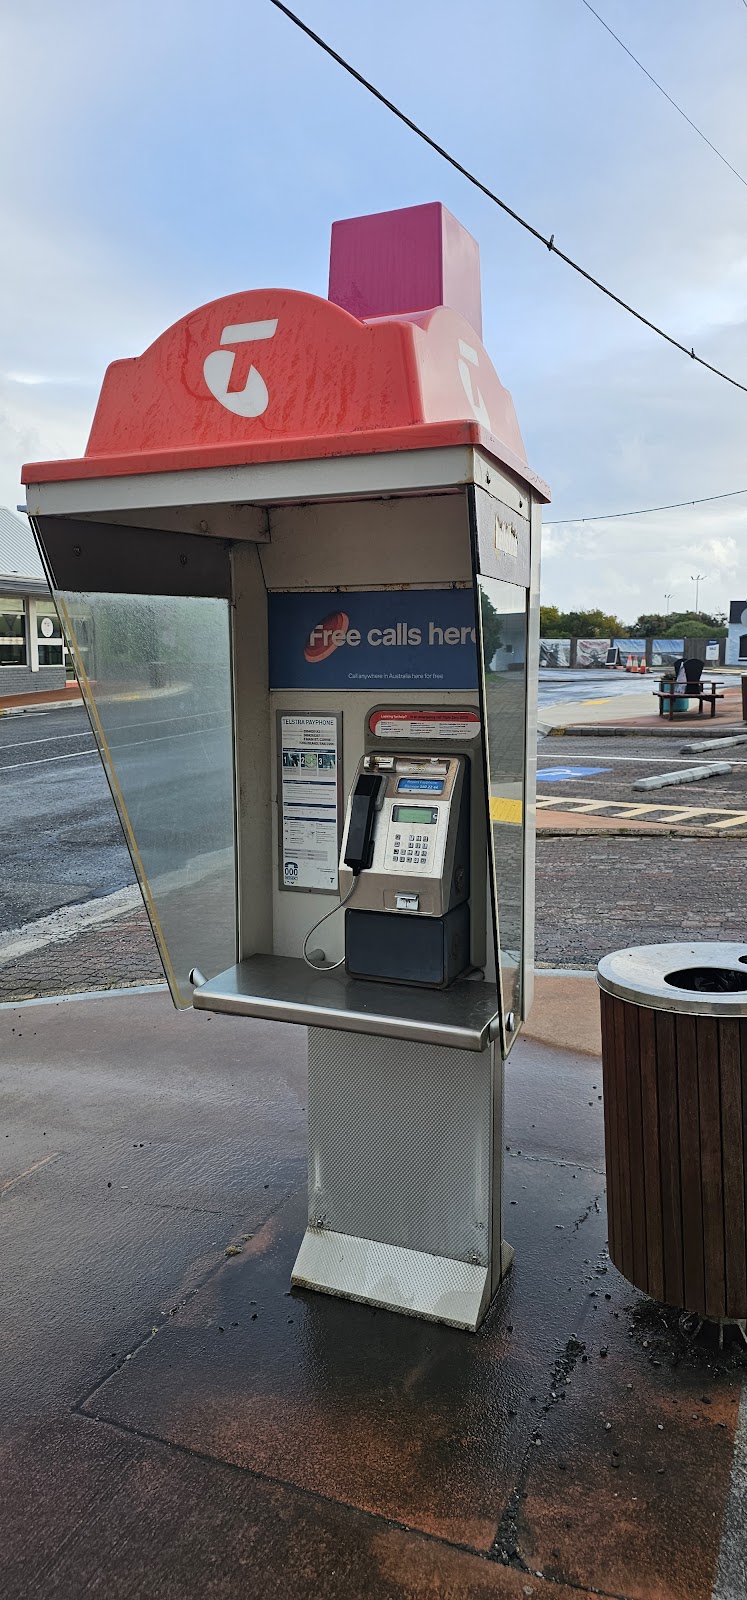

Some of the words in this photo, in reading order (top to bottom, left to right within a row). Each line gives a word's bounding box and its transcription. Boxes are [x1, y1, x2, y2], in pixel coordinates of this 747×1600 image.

[309, 624, 361, 647] Free
[367, 622, 422, 646] calls
[284, 756, 287, 764] 1
[301, 757, 305, 765] 2
[284, 867, 299, 876] 000
